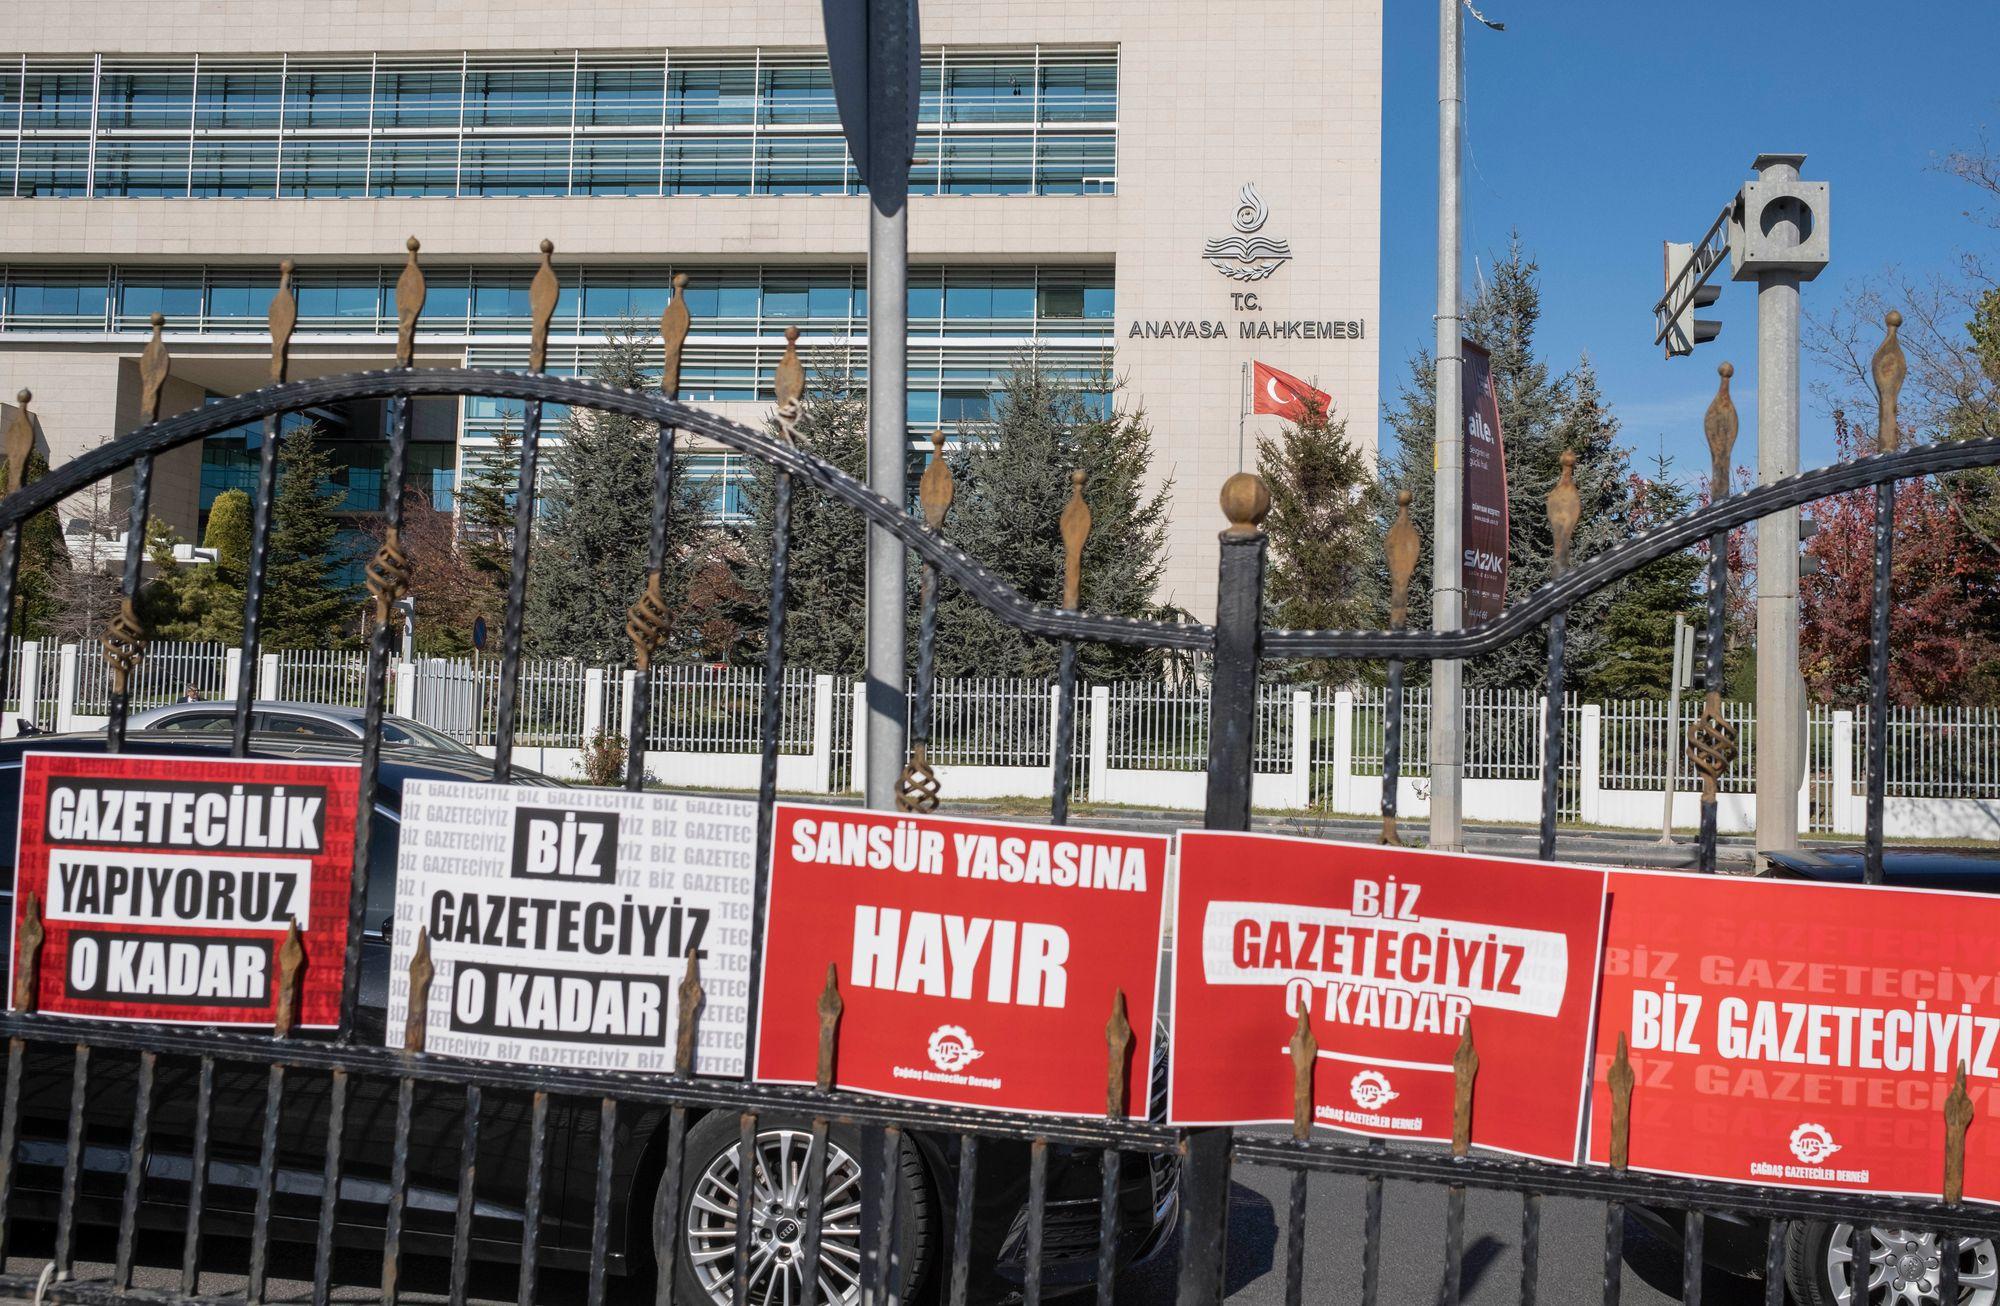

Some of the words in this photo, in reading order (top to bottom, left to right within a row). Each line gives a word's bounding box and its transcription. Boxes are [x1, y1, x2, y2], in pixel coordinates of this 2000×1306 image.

[1230, 292, 1263, 312] T.C.
[1128, 320, 1229, 339] ANAYASA
[1239, 318, 1366, 340] MAHKEMESİ
[1463, 548, 1504, 574] SAZAK
[48, 784, 322, 850] GAZETECİLİK
[426, 804, 509, 827] GAZETECİYİZ
[652, 816, 677, 838] BİZ
[425, 829, 507, 853] GAZETECİYİZ
[526, 811, 604, 877] BİZ
[650, 842, 676, 864] BİZ
[791, 818, 945, 875] SANSÜR
[953, 833, 1147, 892] YASASINA
[423, 854, 506, 879] GAZETECİYİZ
[649, 868, 675, 890] BİZ
[59, 862, 298, 923] YAPIYORUZ
[1352, 874, 1422, 922] BİZ
[430, 889, 710, 960] GAZETECİYİZ
[70, 937, 99, 992] O
[106, 939, 267, 999] KADAR
[850, 904, 1070, 1009] HAYIR
[1232, 918, 1526, 995] GAZETECİYİZ
[1605, 944, 1680, 982] BİZ
[456, 968, 486, 1024] O
[494, 972, 661, 1037] KADAR
[1286, 979, 1312, 1018] O
[1324, 981, 1472, 1037] KADAR
[1631, 981, 1703, 1054] BİZ
[1717, 996, 2000, 1079] GAZETECİYİZ
[1750, 1161, 1784, 1178] ÇAĞDAŞ
[1784, 1165, 1836, 1181] GAZETECİLER
[1837, 1168, 1870, 1184] DERNEĞİ
